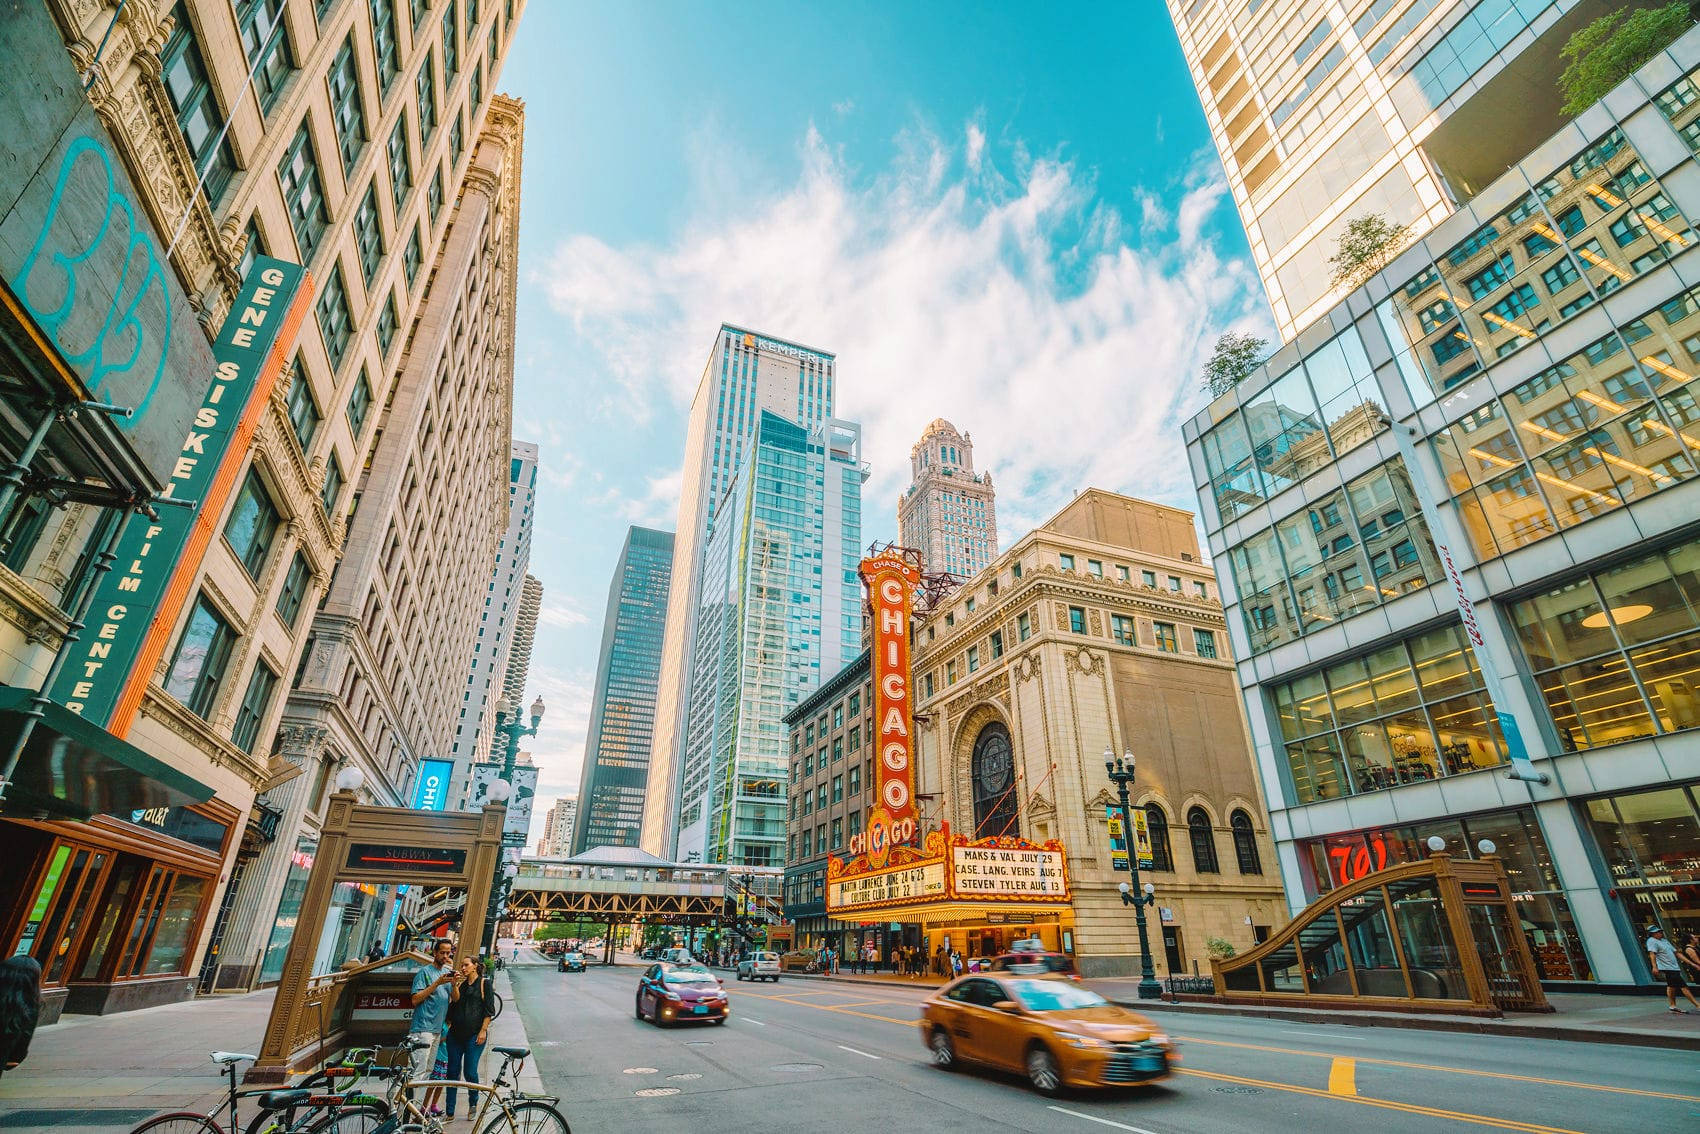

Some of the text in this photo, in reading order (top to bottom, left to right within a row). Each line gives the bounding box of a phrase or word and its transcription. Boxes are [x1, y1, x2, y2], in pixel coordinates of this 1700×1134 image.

[231, 268, 284, 348] GENE
[758, 339, 817, 364] KEMPER
[118, 525, 162, 593] FILM
[872, 560, 901, 571] CHASE
[65, 605, 127, 715] CENTER
[880, 579, 909, 809] CHICAGO
[849, 817, 912, 855] CHICAGO
[385, 847, 433, 860] SUBWAY
[964, 851, 1053, 864] MAKS & VAL JULY 29
[840, 881, 857, 894] MARTIN
[858, 876, 883, 891] LAWRENCE
[886, 873, 899, 886] JUNE
[901, 873, 908, 884] 24
[917, 868, 925, 881] 25
[1011, 867, 1035, 877] VEIRS
[1040, 868, 1055, 877] AUG
[1058, 868, 1062, 878] 7
[851, 884, 911, 903] CULTURE CLUB JULY 22
[961, 879, 1060, 891] STEVEN TYLER AUG 13
[372, 996, 401, 1007] Lake
[403, 1010, 414, 1020] ct
